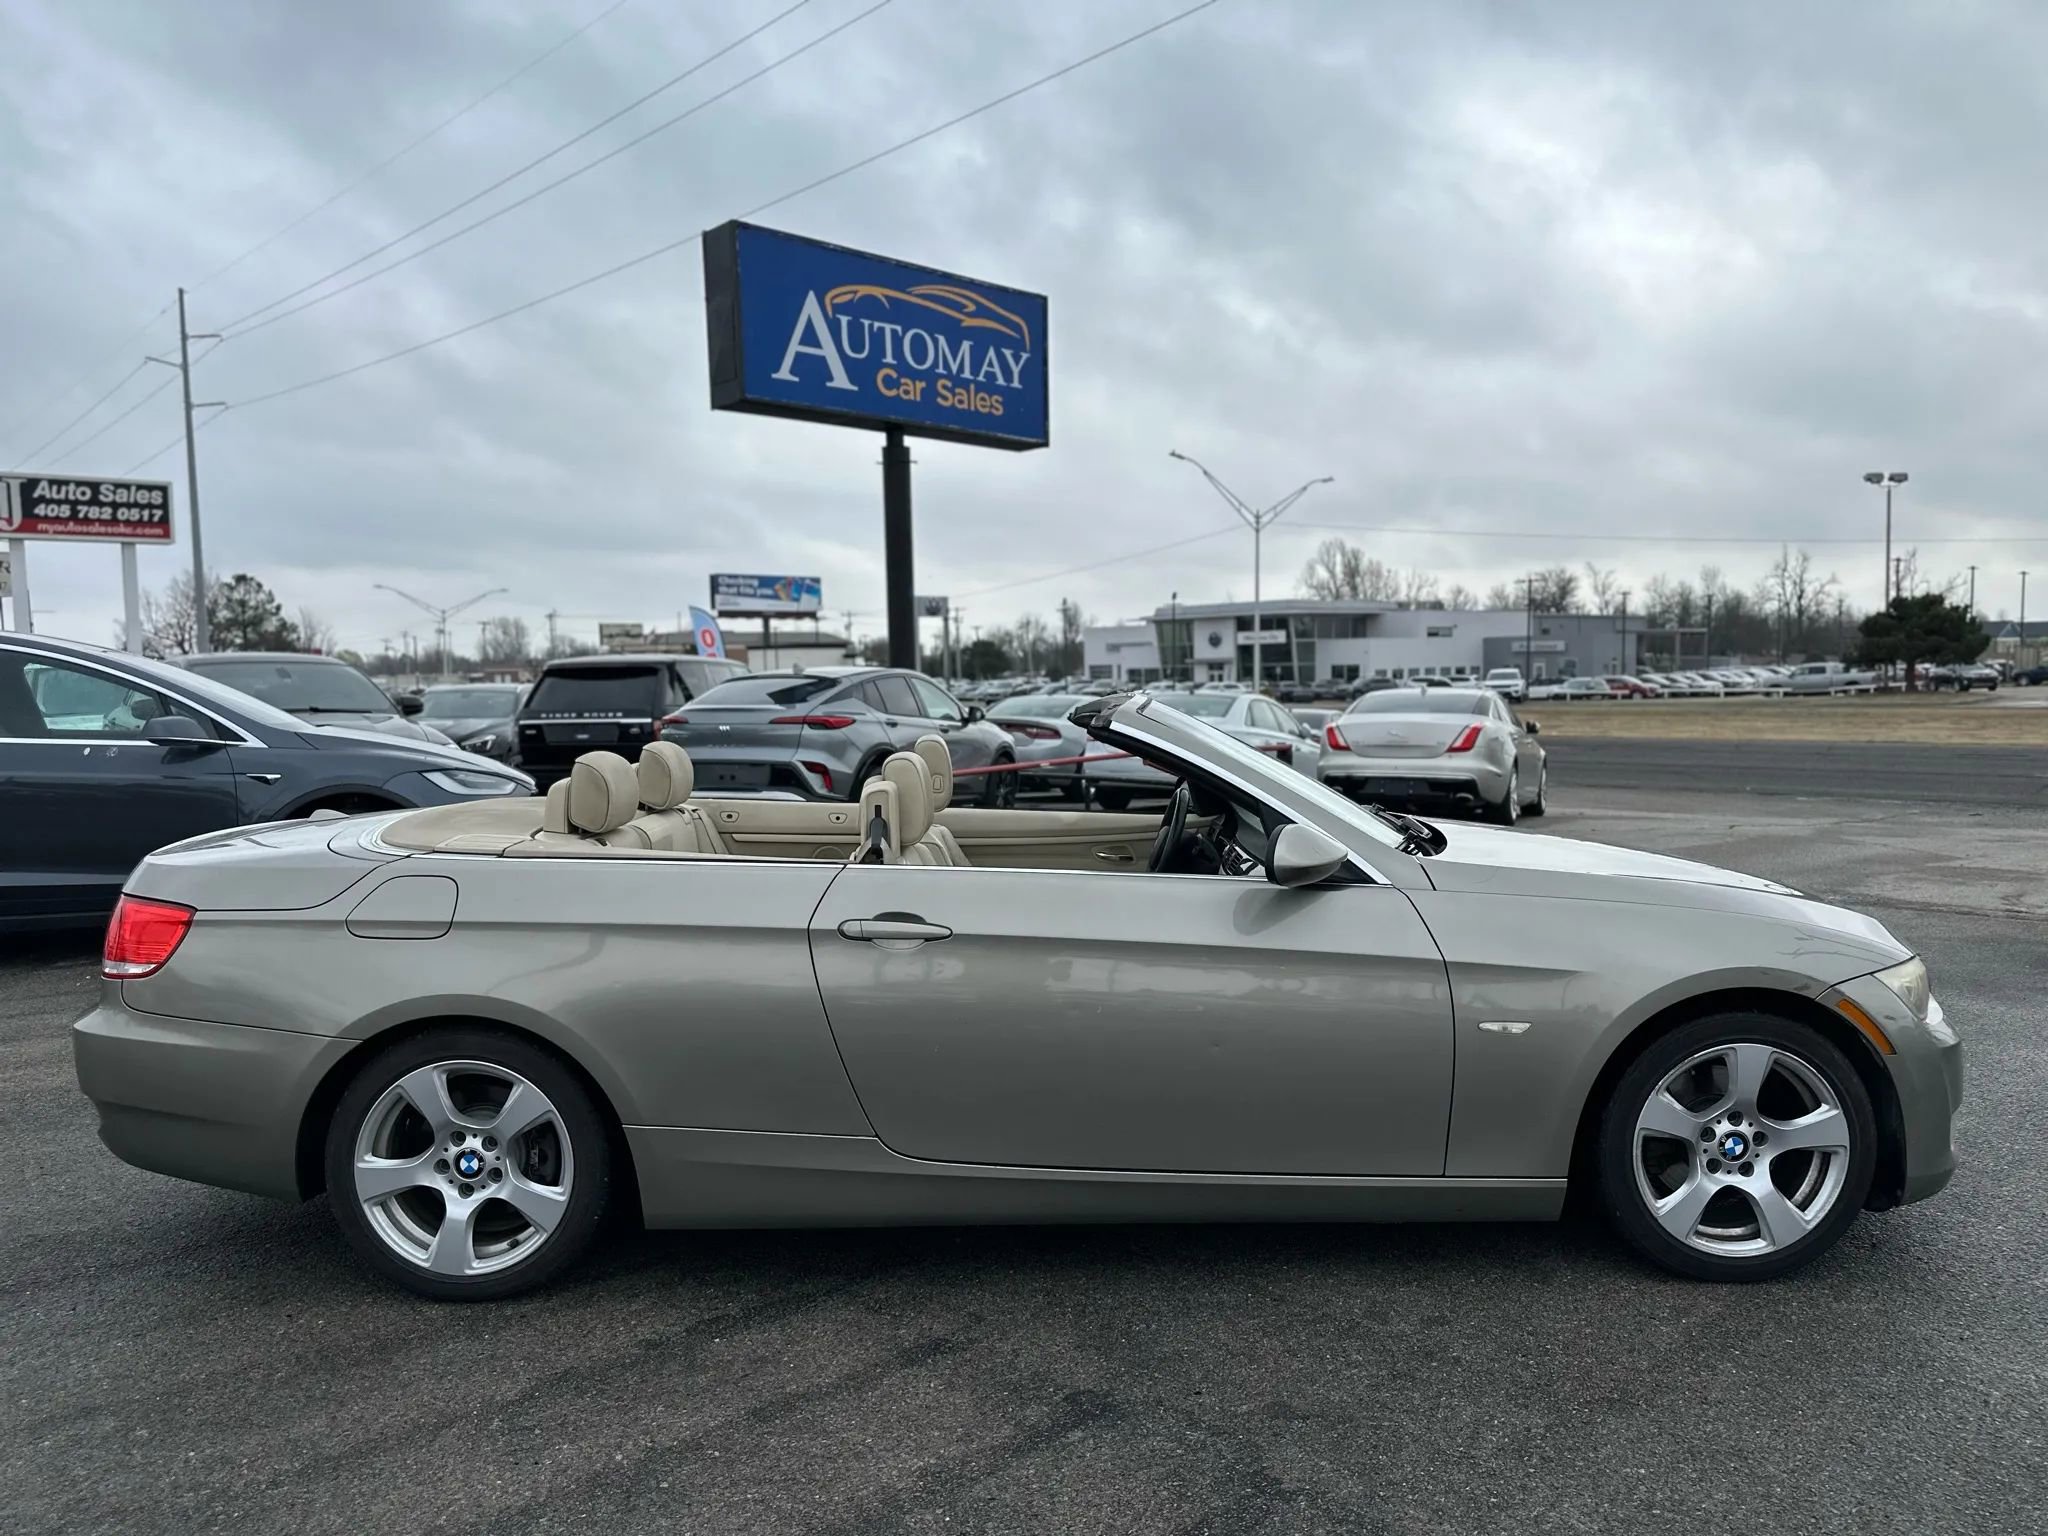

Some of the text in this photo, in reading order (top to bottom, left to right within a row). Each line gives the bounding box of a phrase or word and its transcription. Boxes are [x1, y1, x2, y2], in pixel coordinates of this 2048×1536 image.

[771, 289, 1031, 391] AUTOMAY
[876, 368, 1004, 416] Car Sales
[32, 480, 164, 505] Auto Sales
[34, 503, 164, 522] 405 782 0517
